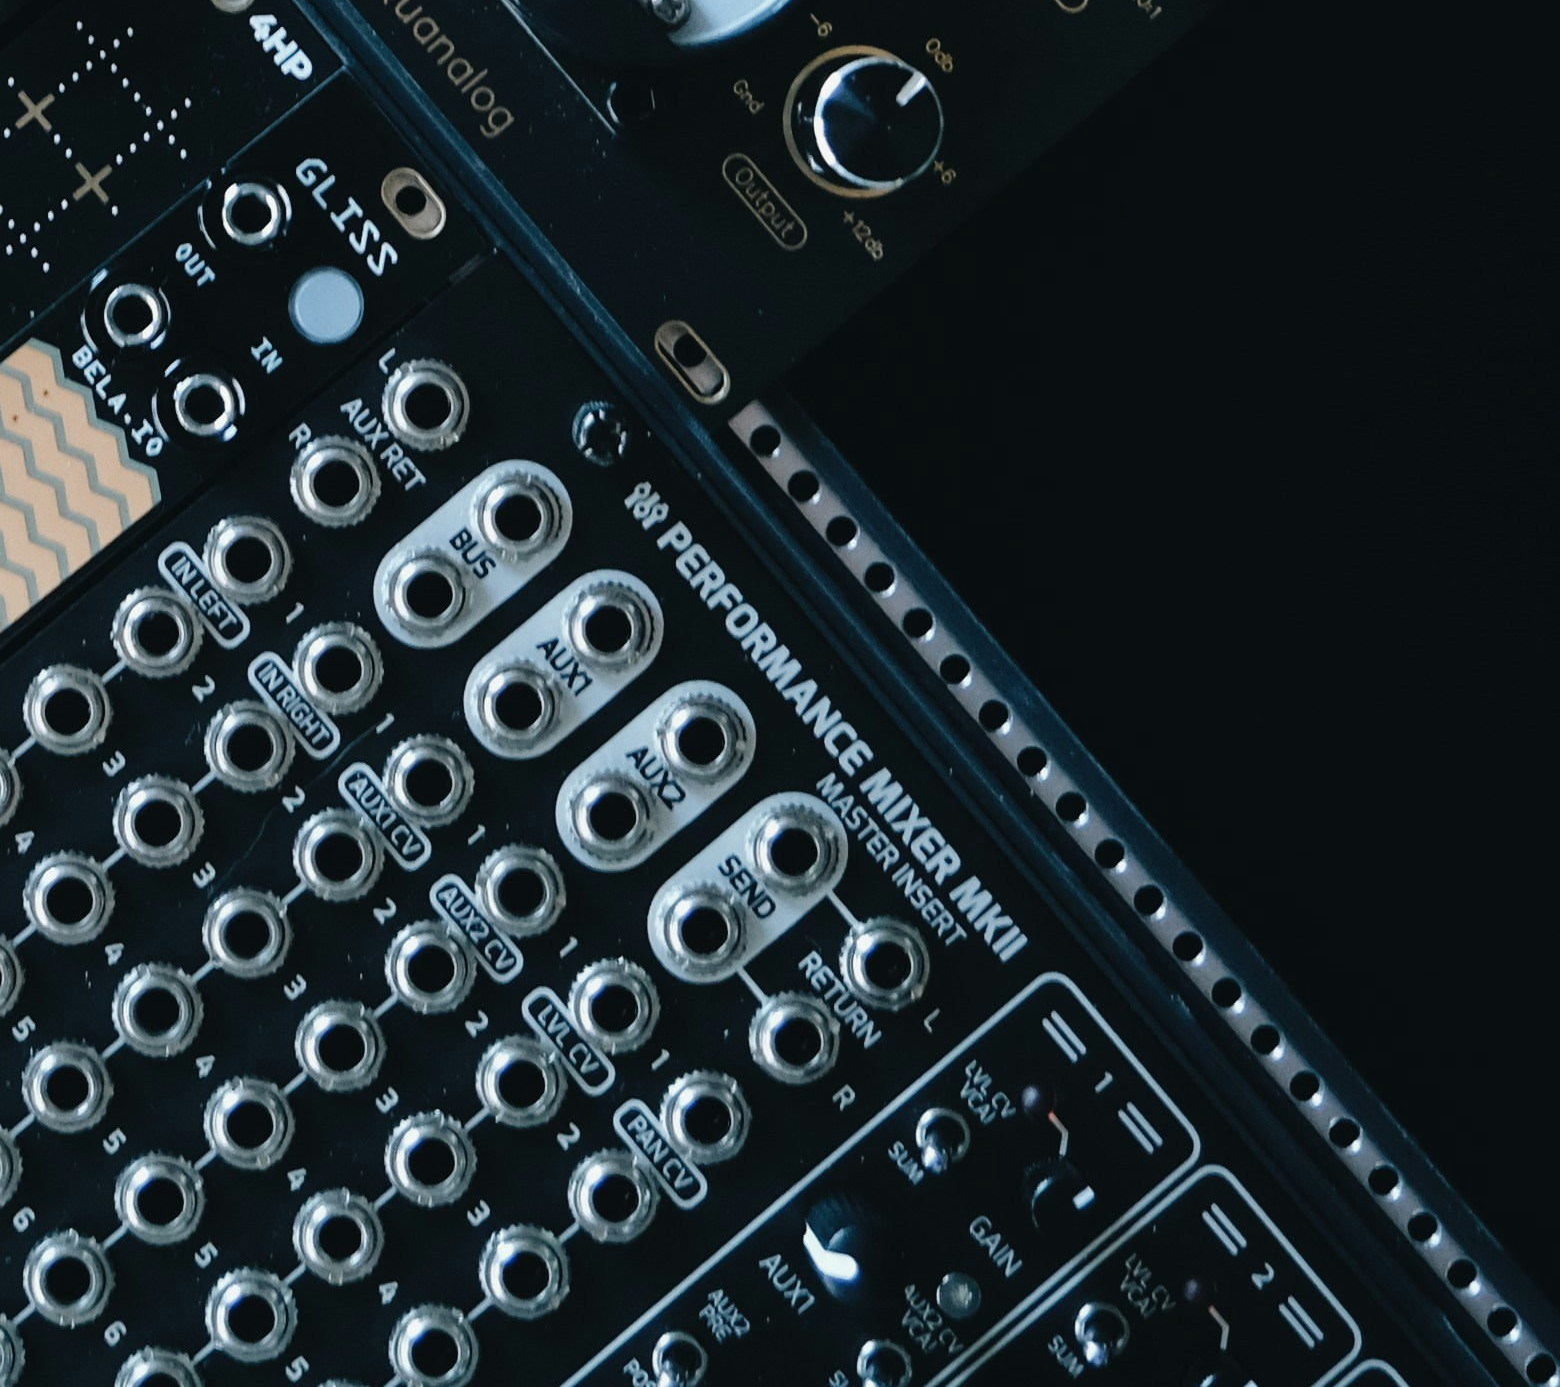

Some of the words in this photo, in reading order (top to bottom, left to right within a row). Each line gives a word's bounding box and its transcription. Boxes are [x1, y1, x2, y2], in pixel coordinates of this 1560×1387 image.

[247, 12, 314, 82] 4HP
[293, 156, 400, 278] GLISS
[732, 166, 796, 241] Output
[172, 241, 217, 289] OUT
[248, 335, 284, 376] IN
[337, 396, 391, 452] AUX
[377, 441, 428, 493] RET
[447, 527, 497, 581] BUS
[534, 637, 594, 699] AUX1
[654, 519, 875, 779] PERFORMANCE
[856, 765, 963, 888] MIXER
[946, 873, 1029, 964] MKII
[624, 746, 687, 813] AUX2
[716, 855, 777, 921] SEND
[813, 770, 901, 873] MASTER
[889, 861, 969, 947] INSERT
[796, 949, 883, 1051] RETURN
[966, 1214, 1024, 1280] GAIN
[756, 1252, 816, 1316] AUX1
